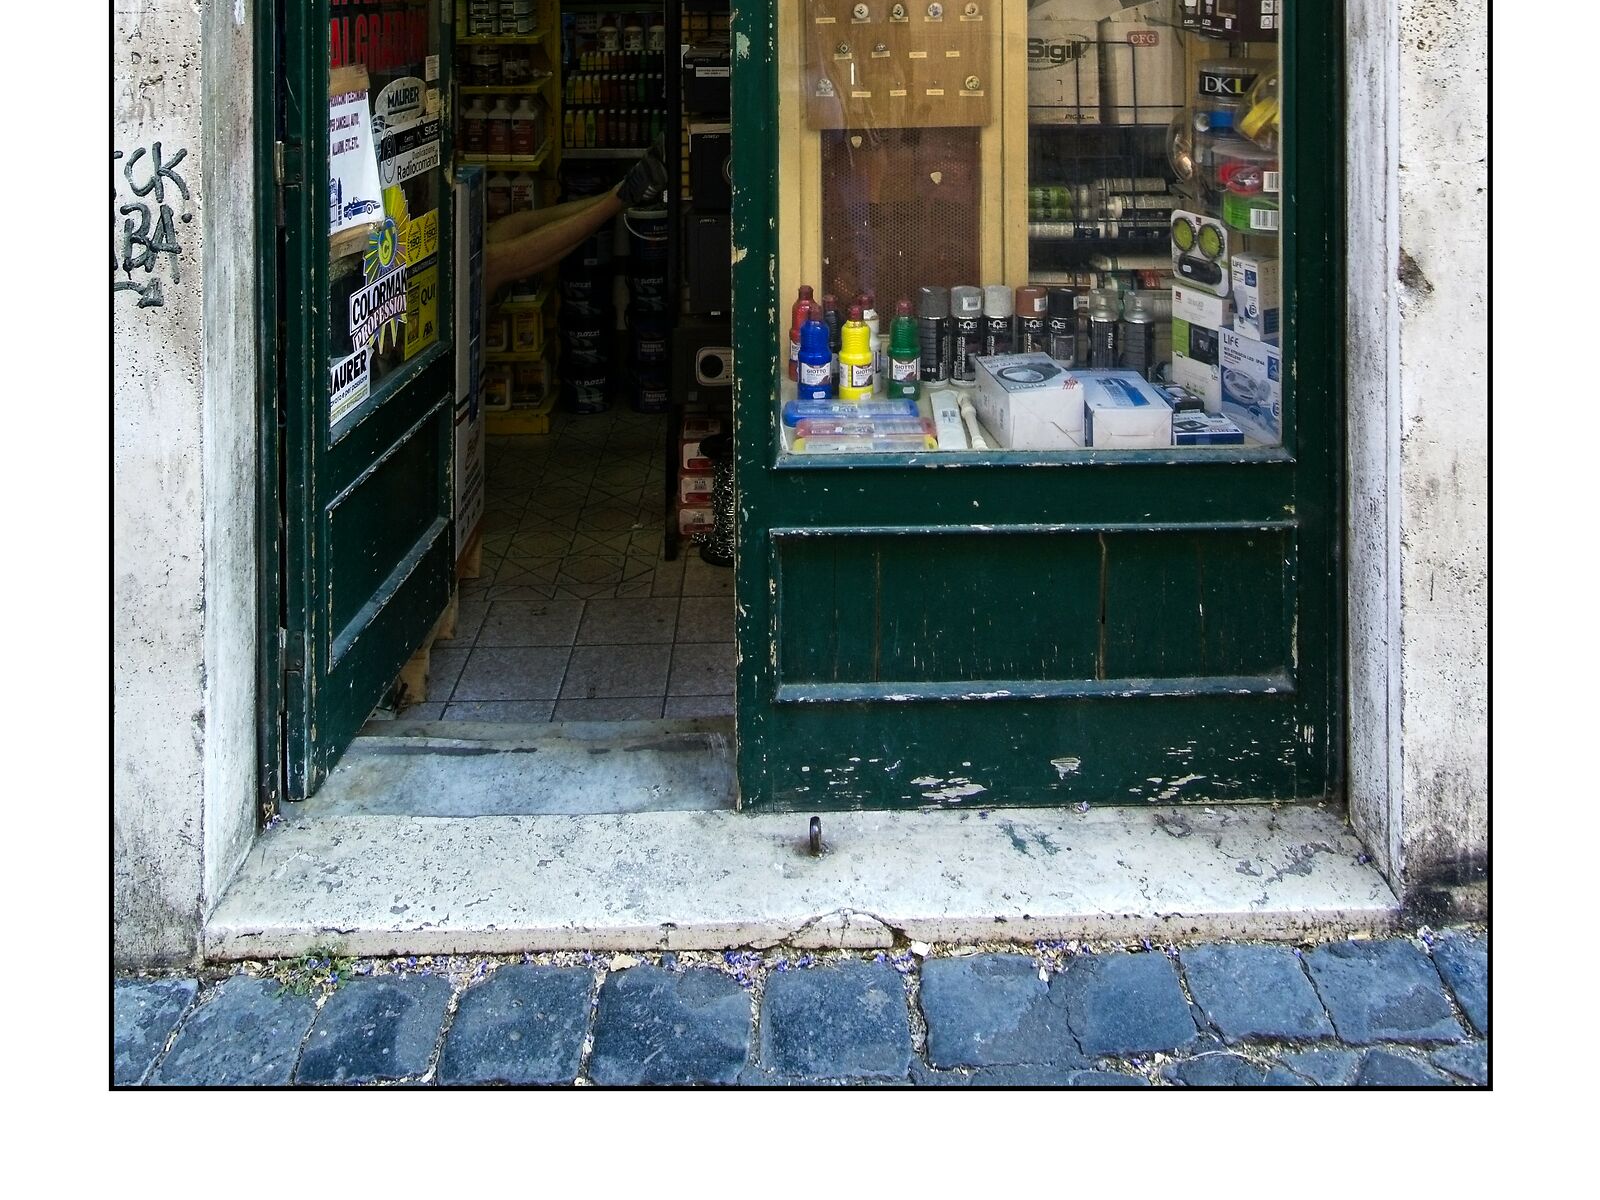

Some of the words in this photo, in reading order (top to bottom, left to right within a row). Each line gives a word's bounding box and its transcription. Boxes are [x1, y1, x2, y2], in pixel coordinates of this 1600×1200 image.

[1130, 34, 1157, 44] CFG
[387, 86, 419, 109] MAURER
[114, 141, 190, 204] CK
[1223, 332, 1240, 348] LIFE
[330, 349, 368, 396] AURER
